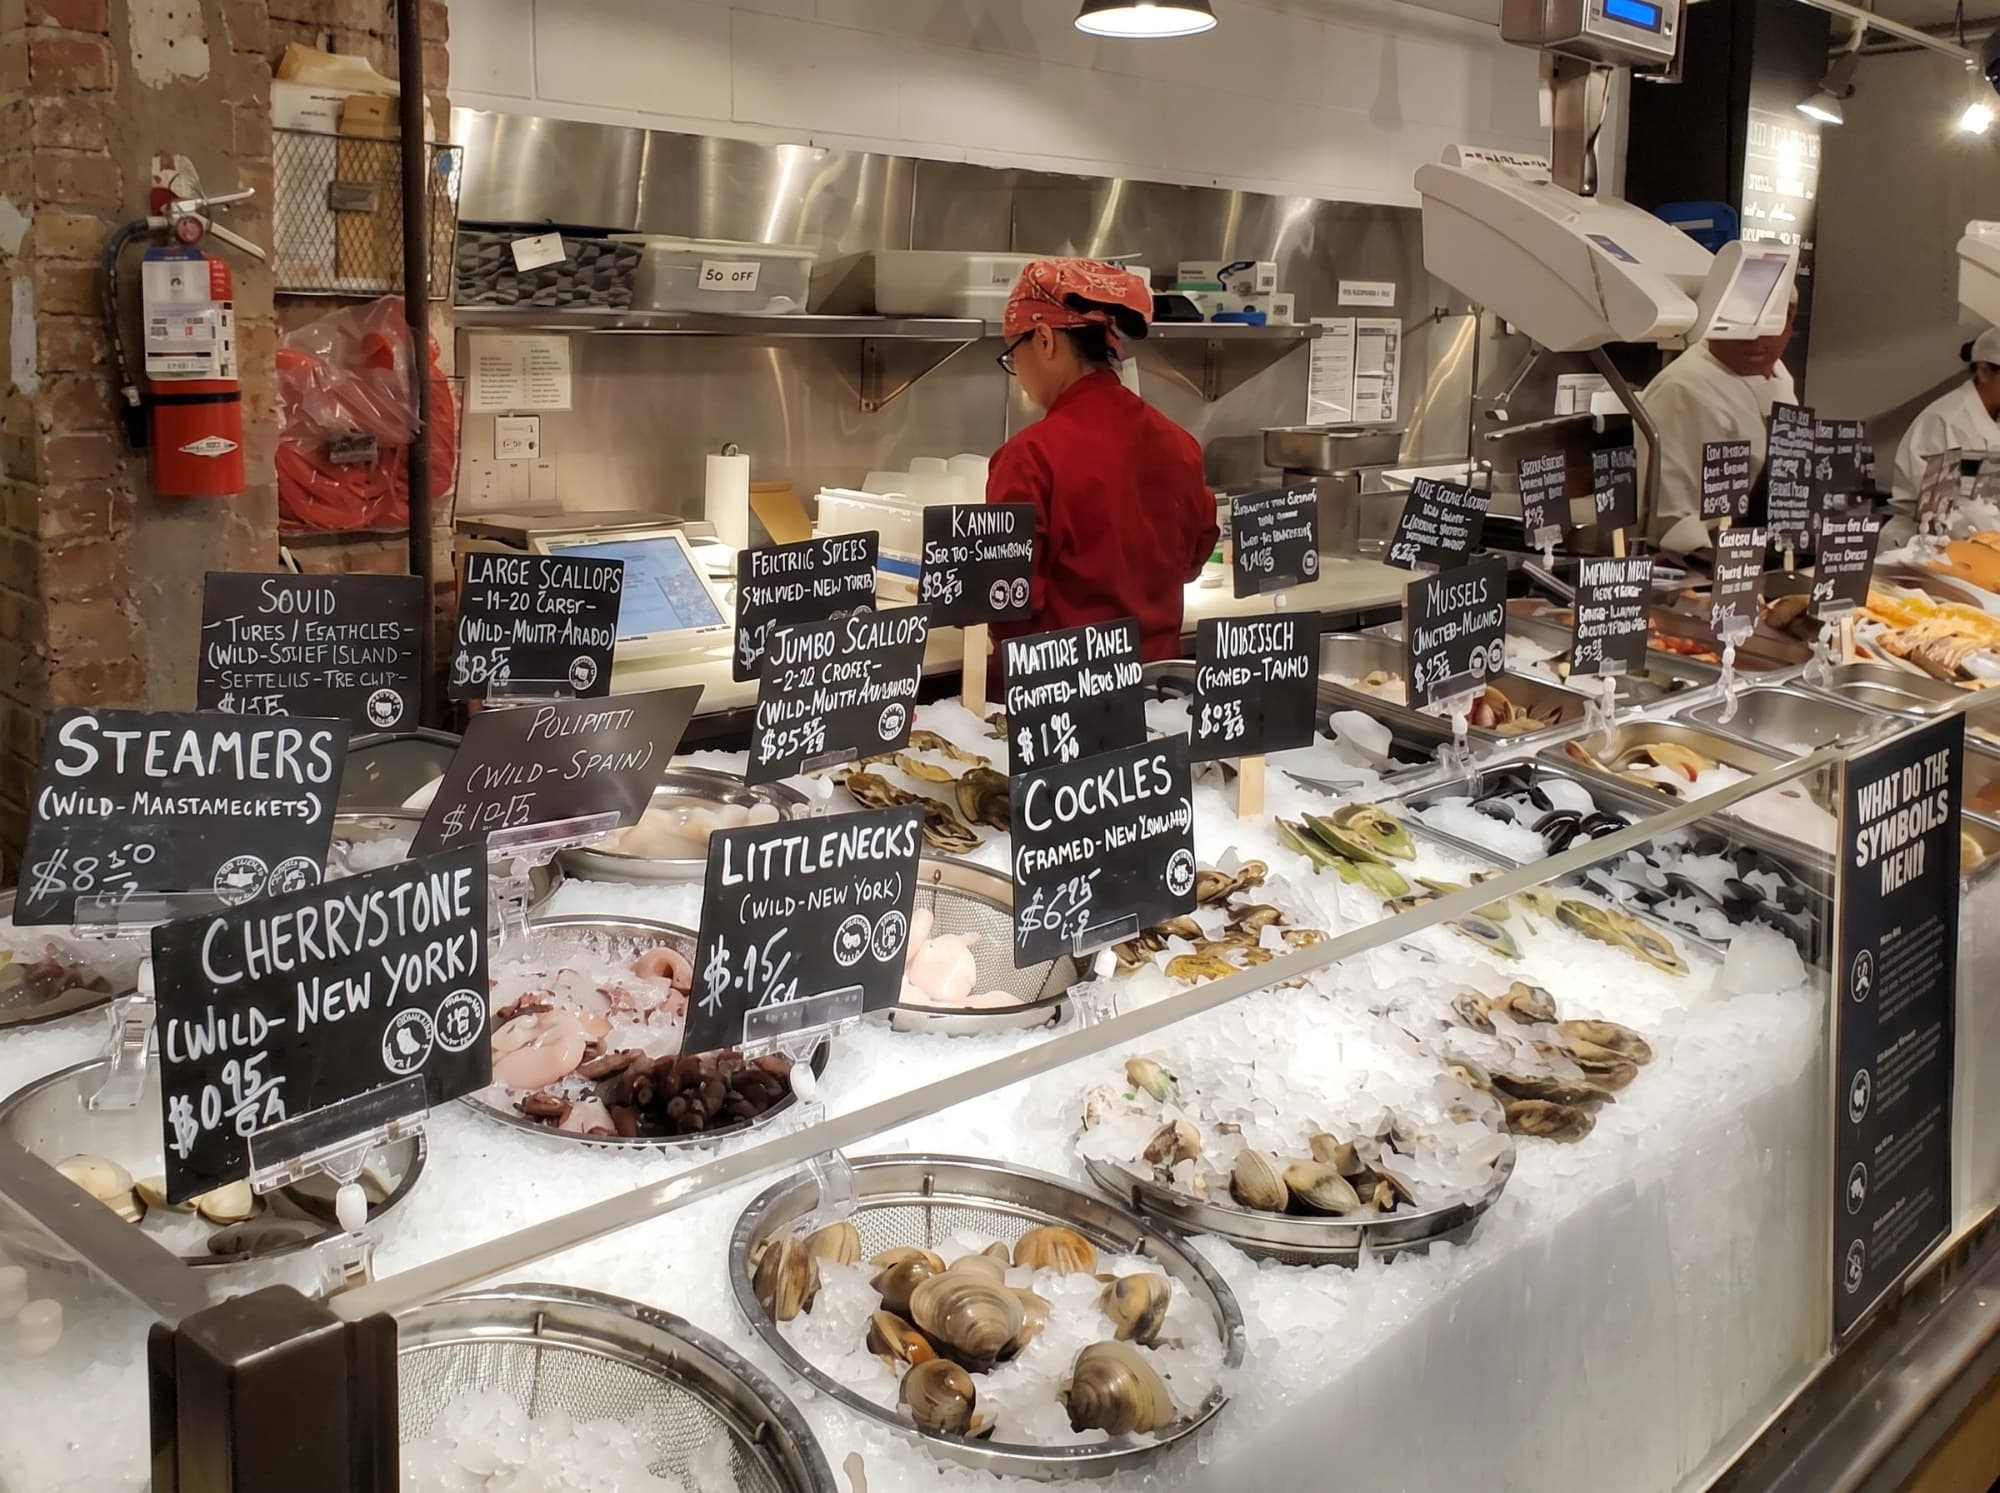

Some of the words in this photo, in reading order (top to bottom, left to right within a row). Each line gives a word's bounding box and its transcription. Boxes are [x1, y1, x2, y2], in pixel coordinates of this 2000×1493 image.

[468, 555, 531, 586] LARGE
[538, 559, 622, 594] SCALLOPS
[1426, 577, 1488, 618] MUSSELS
[770, 628, 836, 666] JUMBO
[842, 616, 929, 654] SCALLOPS
[1085, 626, 1133, 662] PANEL
[54, 715, 334, 784] STEAMERS
[1024, 754, 1173, 831] COCKLES
[1857, 771, 1900, 826] WHAT
[1902, 761, 1921, 804] DO
[1924, 748, 1950, 793] THE
[722, 820, 919, 886] LITTLENECKS
[853, 871, 903, 905] YORK)
[201, 867, 472, 984] CHERRYSTONE
[297, 971, 371, 1034] NEW
[381, 928, 479, 1007] YORK)
